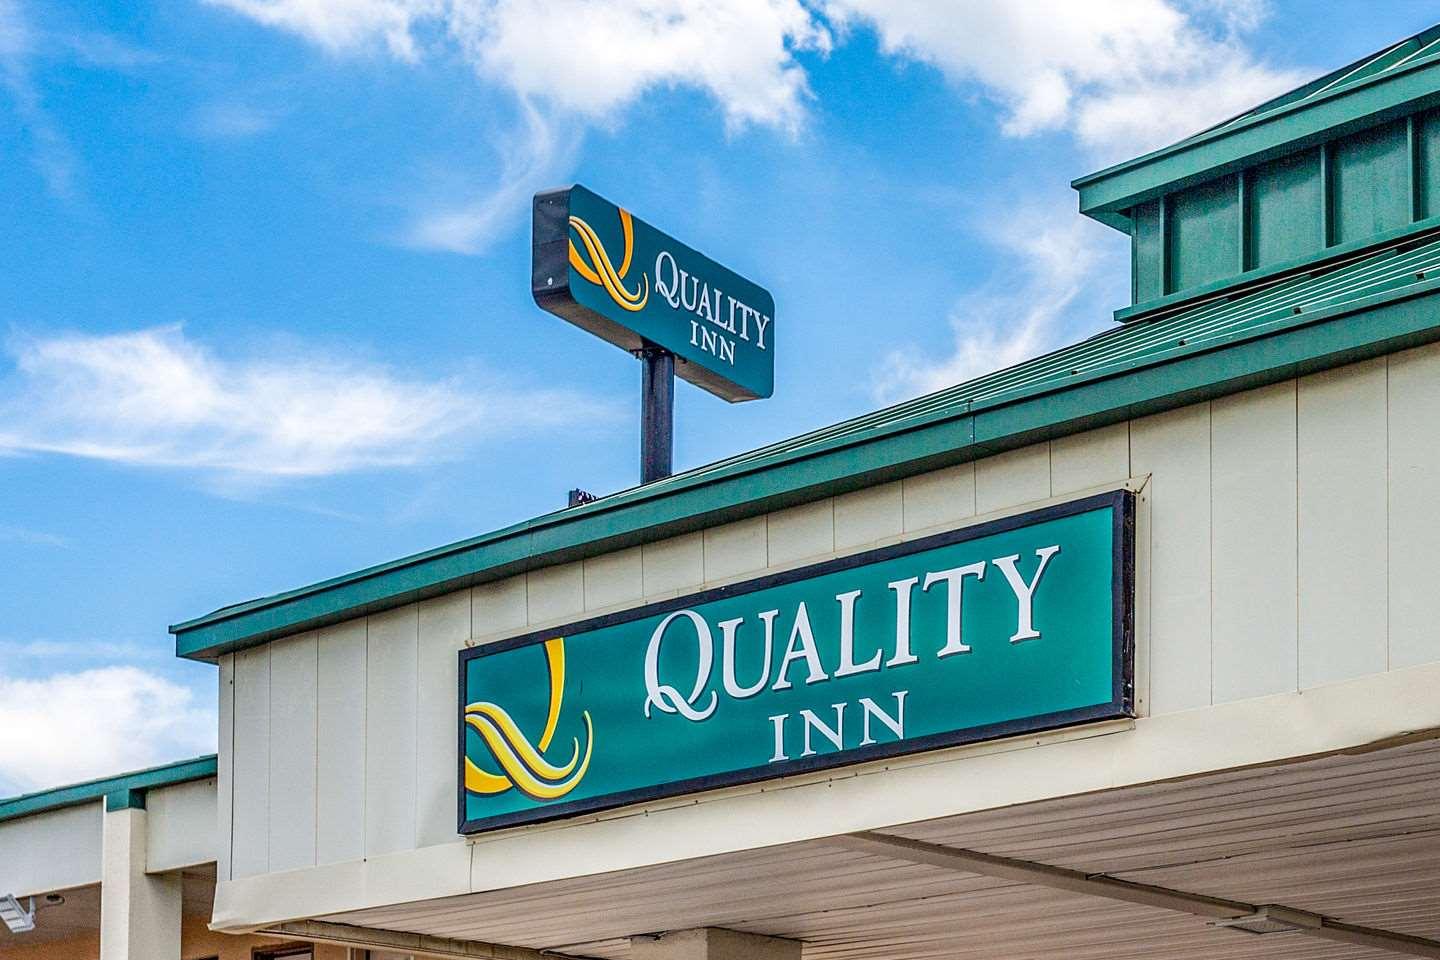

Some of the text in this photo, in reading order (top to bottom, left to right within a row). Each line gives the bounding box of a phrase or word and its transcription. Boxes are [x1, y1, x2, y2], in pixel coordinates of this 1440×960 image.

[655, 251, 771, 349] QUALITY
[690, 320, 736, 365] INN
[644, 545, 1060, 721] QUALITY
[769, 691, 909, 764] INN
